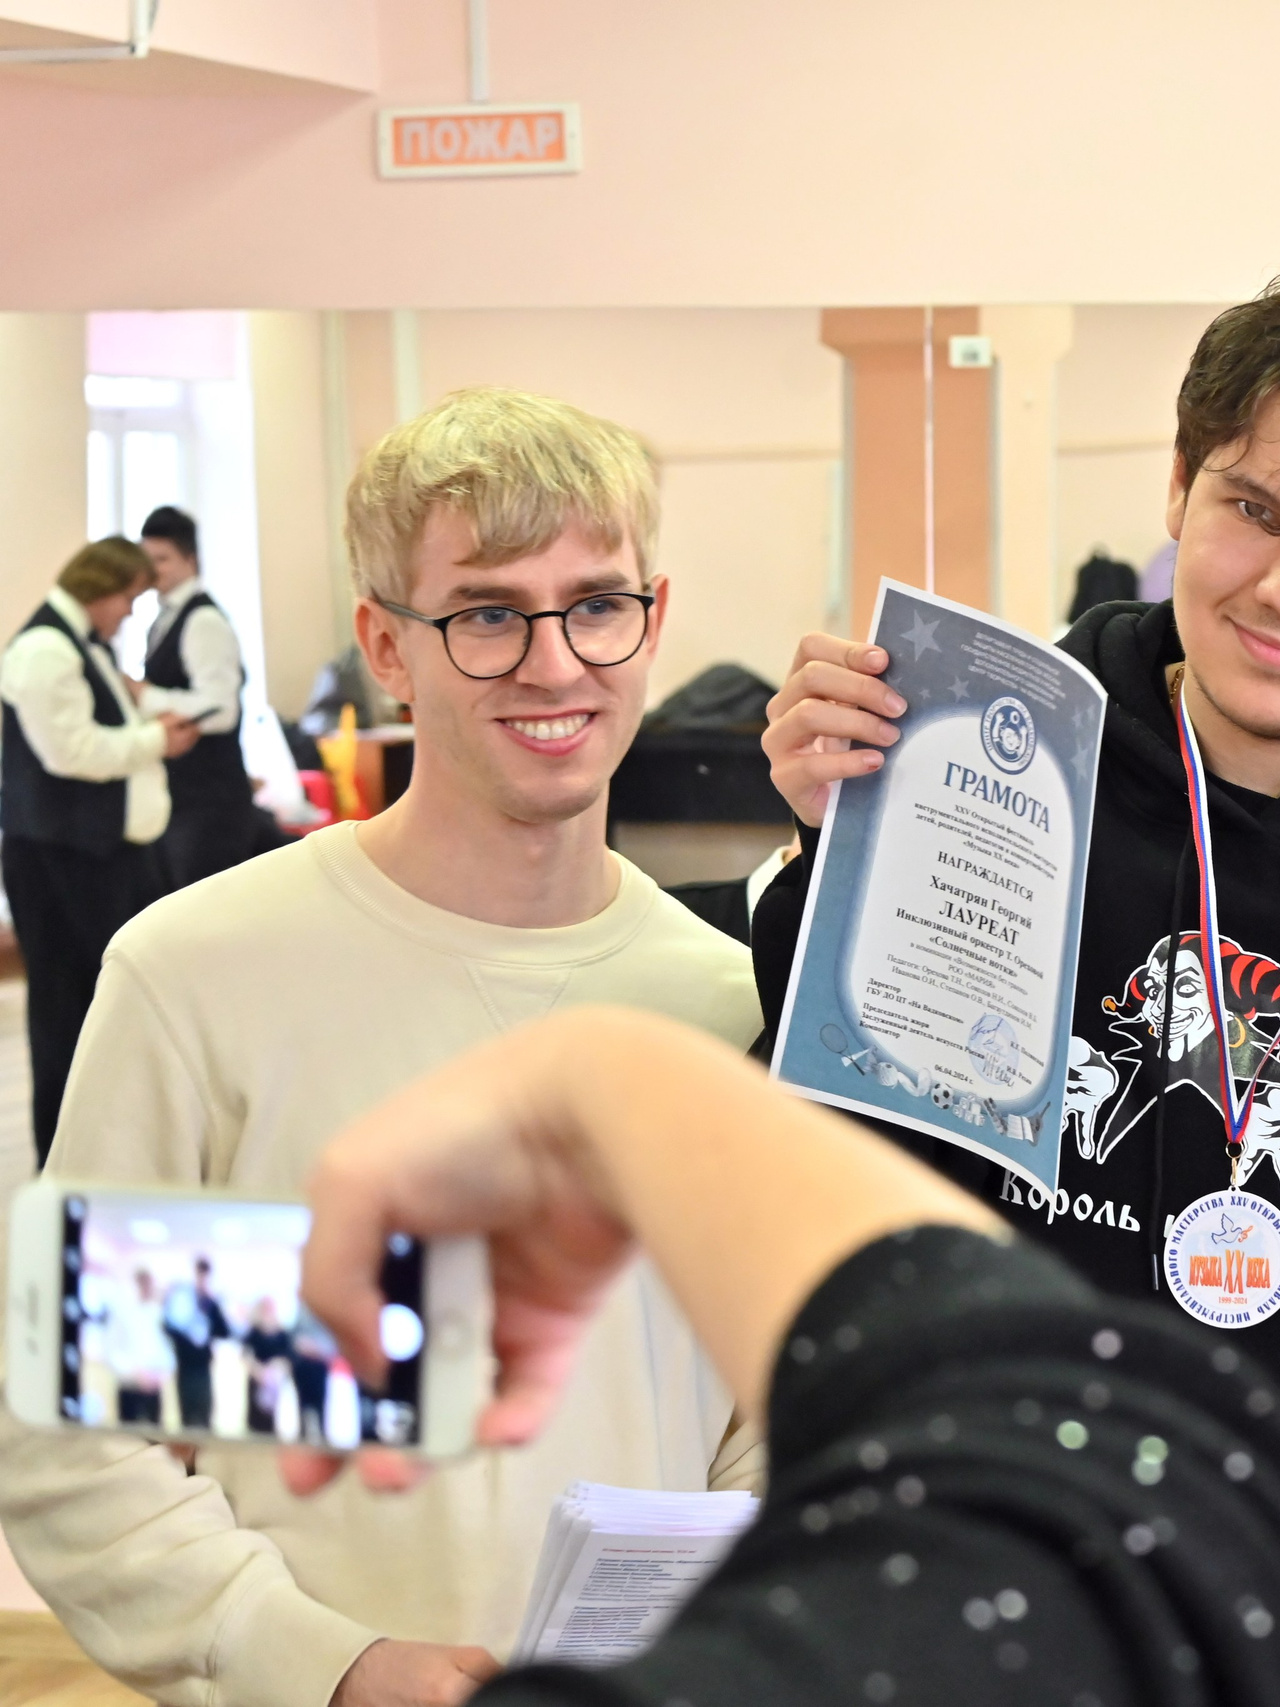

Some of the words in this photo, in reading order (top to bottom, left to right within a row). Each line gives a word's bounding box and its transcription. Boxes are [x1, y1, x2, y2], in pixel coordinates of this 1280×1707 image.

[402, 116, 560, 160] ПОЖАР
[943, 761, 1050, 833] ГРАМОТА
[937, 850, 1034, 902] НАГРАЖДАЕТСЯ
[929, 875, 988, 908] Хачатрян
[990, 898, 1032, 930] Георгий
[938, 900, 1020, 946] ЛАУРЕАТ
[896, 907, 968, 941] Инклюзивный
[970, 936, 1005, 959] оркестр
[929, 935, 988, 964] «Солнечные
[989, 959, 1018, 979] нотки»
[867, 977, 902, 994] Директор
[859, 1020, 901, 1039] Композитор
[861, 1011, 908, 1031] Заслуженный
[863, 1002, 910, 1022] Председатель
[999, 1169, 1141, 1232] Король
[1172, 1197, 1224, 1245] МАСТЕРСТВА
[1230, 1195, 1250, 1207] XXV
[1168, 1249, 1251, 1324] ИНСТРУМЕНТАЛЬНОГО
[1188, 1255, 1223, 1288] МУЗЫКА
[1223, 1249, 1245, 1294] XX
[1246, 1256, 1271, 1289] ВЕКА
